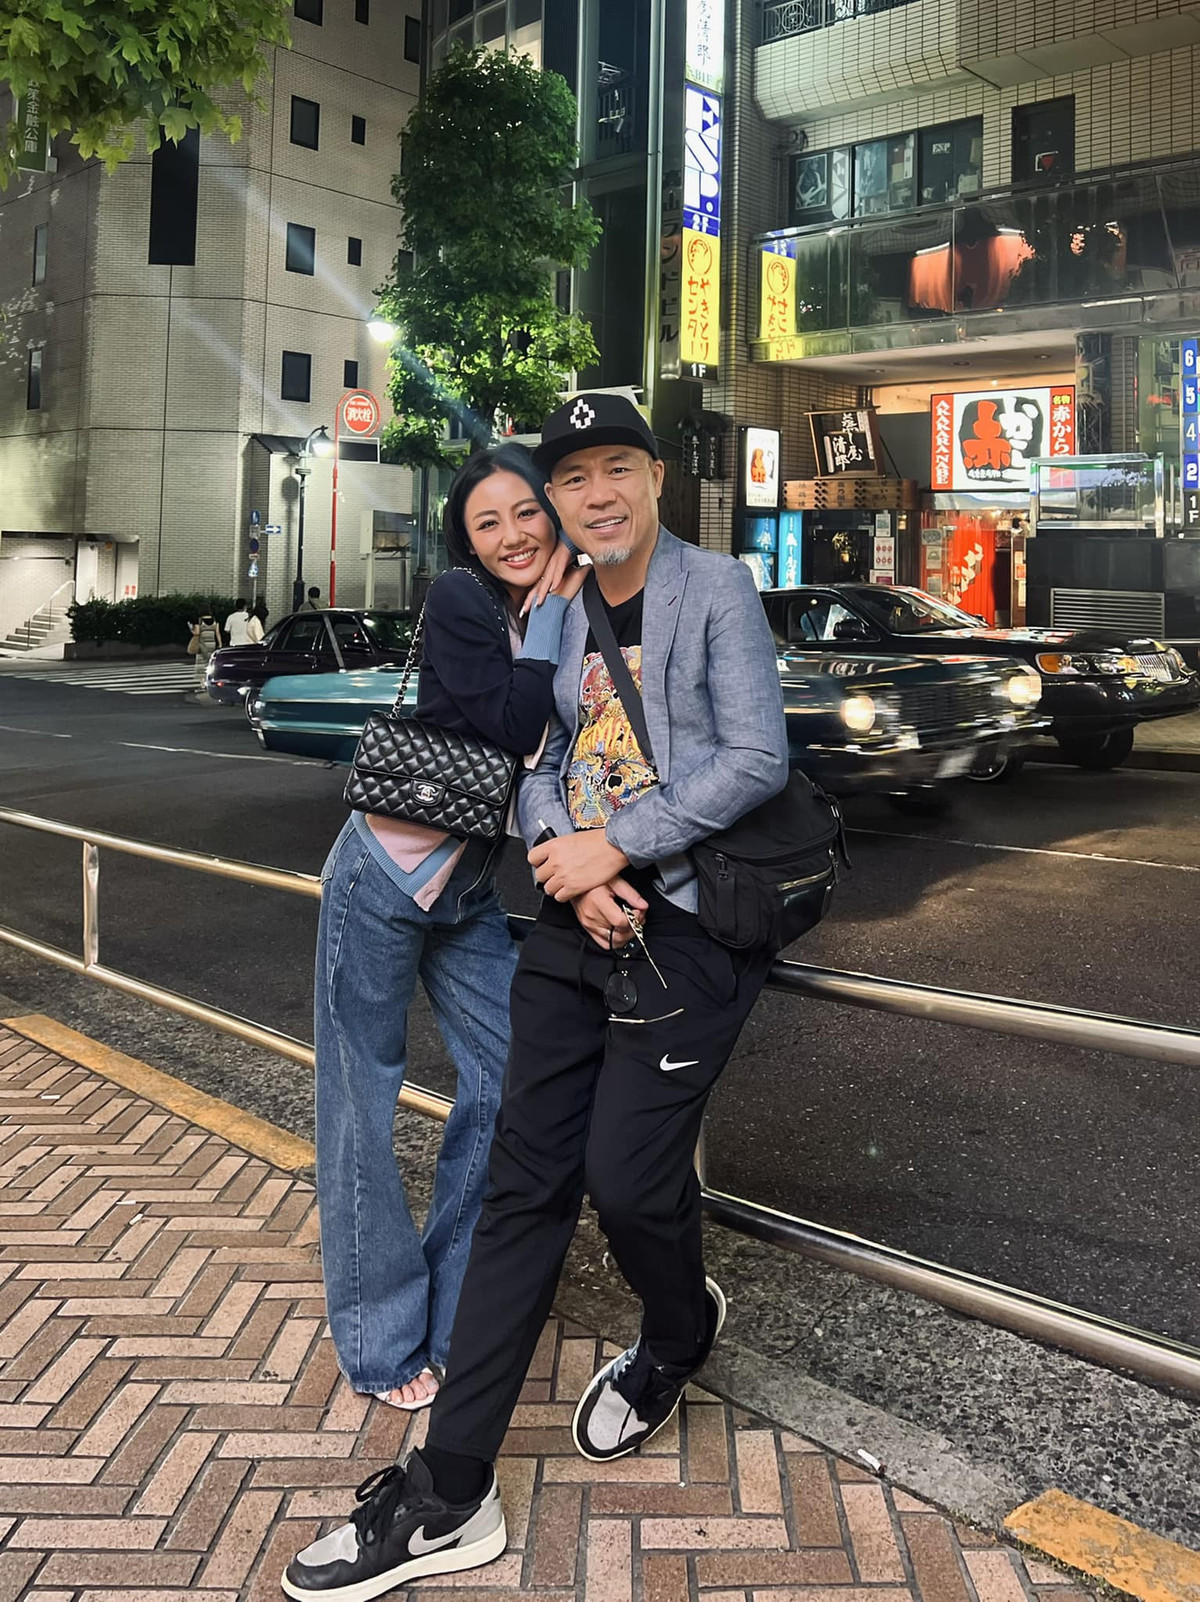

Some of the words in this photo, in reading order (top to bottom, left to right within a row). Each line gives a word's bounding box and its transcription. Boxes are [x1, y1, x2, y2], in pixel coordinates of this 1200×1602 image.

[692, 213, 709, 234] 2F
[687, 275, 699, 356] センター
[700, 277, 711, 361] やきとり
[1185, 350, 1194, 367] 6
[690, 362, 707, 378] 1F
[1185, 386, 1196, 405] 5
[347, 407, 372, 422] 消火栓
[1053, 405, 1072, 457] 赤から
[1186, 422, 1197, 442] 4
[935, 399, 952, 485] AKAKARANABE
[832, 435, 851, 471] 清郎
[1186, 462, 1198, 482] 2
